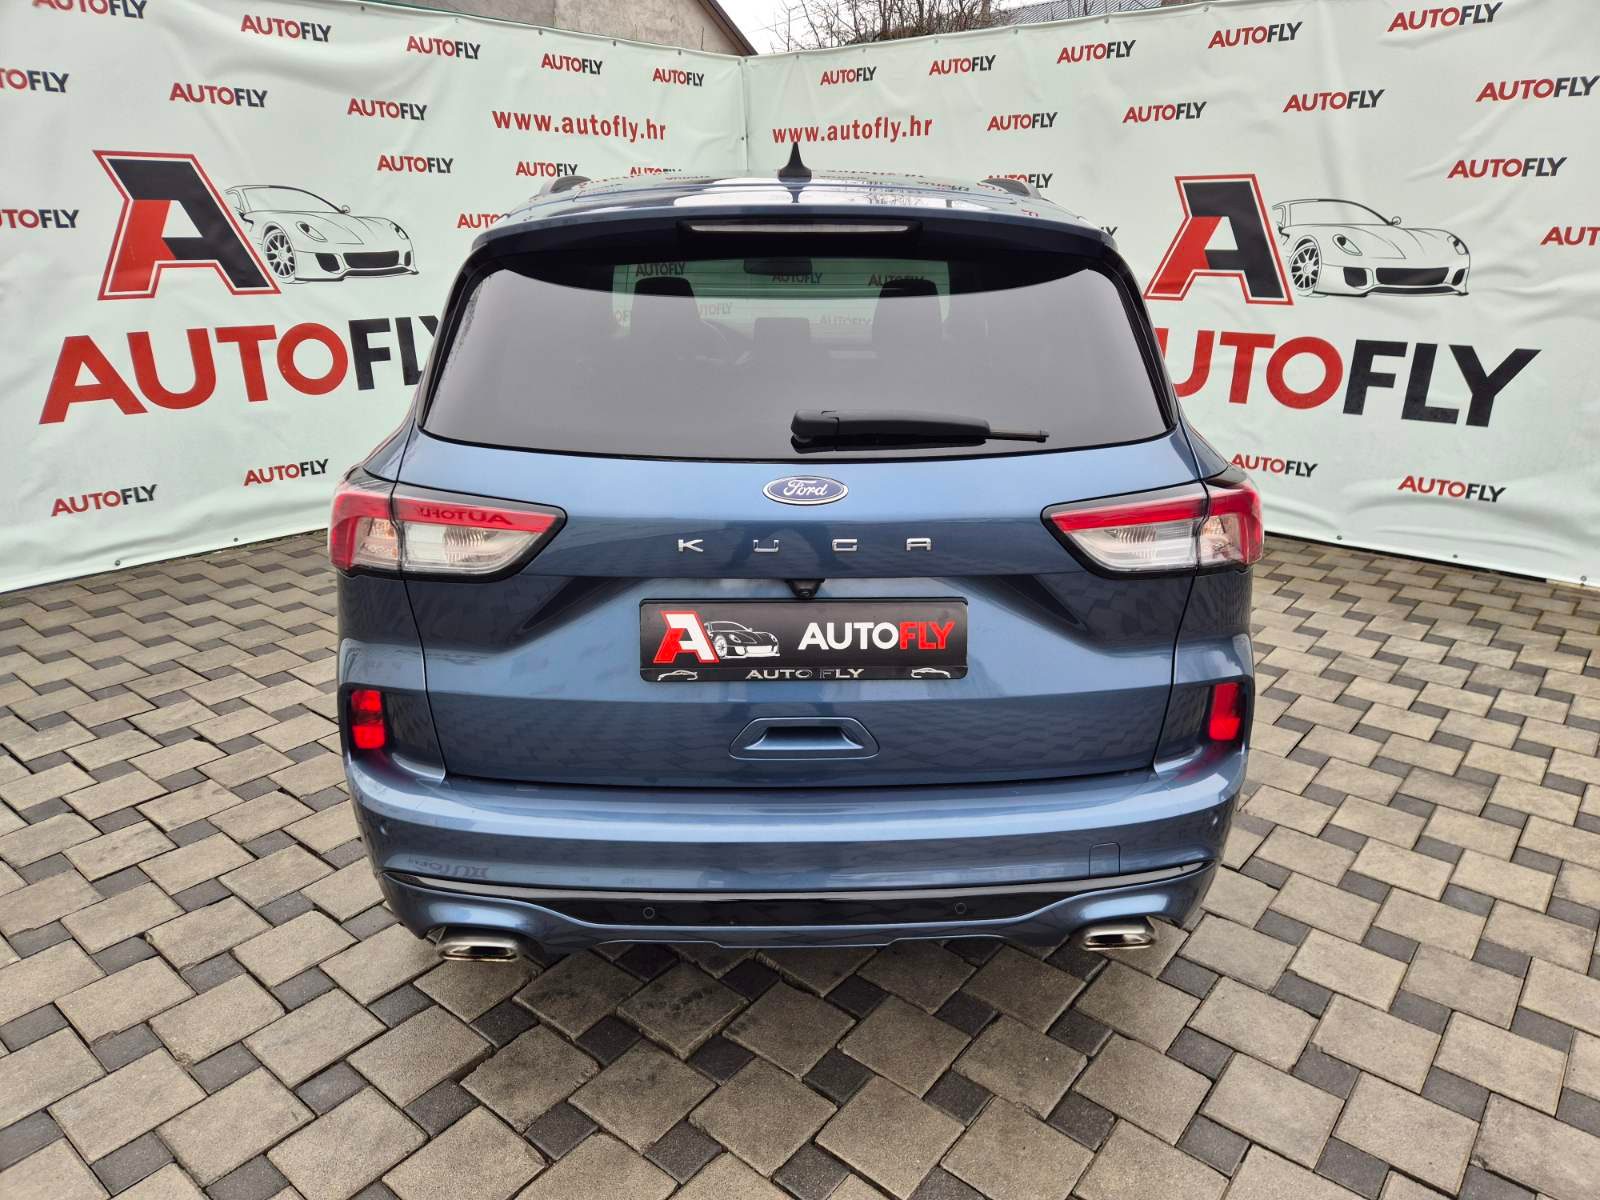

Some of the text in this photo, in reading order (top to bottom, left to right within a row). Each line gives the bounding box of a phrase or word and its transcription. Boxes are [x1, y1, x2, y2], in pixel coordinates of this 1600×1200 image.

[240, 14, 331, 42] AUTOFLY
[1388, 2, 1501, 32] AUTOFLY
[406, 35, 480, 60] AUTOFLY
[1208, 21, 1302, 49] AUTOFLY
[1057, 39, 1136, 64] AUTOFLY
[541, 53, 603, 76] AUTOFLY
[653, 67, 704, 87] AUTOFLY
[820, 66, 876, 86] AUTOFLY
[929, 54, 996, 76] AUTOFLY
[169, 82, 268, 108] AUTOFLY
[1283, 88, 1384, 113] AUTOFLY
[1476, 75, 1600, 102] AUTOFLY
[347, 98, 427, 121] AUTOFLY
[987, 111, 1058, 132] AUTOFLY
[1122, 101, 1206, 124] AUTOFLY
[491, 110, 666, 142] www.autofly.hr
[772, 115, 933, 144] www.autofly.hr
[377, 155, 453, 175] AUTOFLY
[515, 161, 578, 178] AUTOFLY
[1447, 157, 1567, 179] AUTOFLY
[38, 315, 439, 425] AUTOFL
[244, 458, 328, 486] AUTOFLY
[1231, 453, 1318, 478] AUTOFLY
[51, 484, 158, 516] AUTOFLY
[783, 480, 828, 497] Ford
[1397, 475, 1506, 502] AUTOFLY
[678, 537, 932, 553] KUGA
[798, 620, 956, 650] AUTOFLY
[745, 668, 813, 679] AUTO
